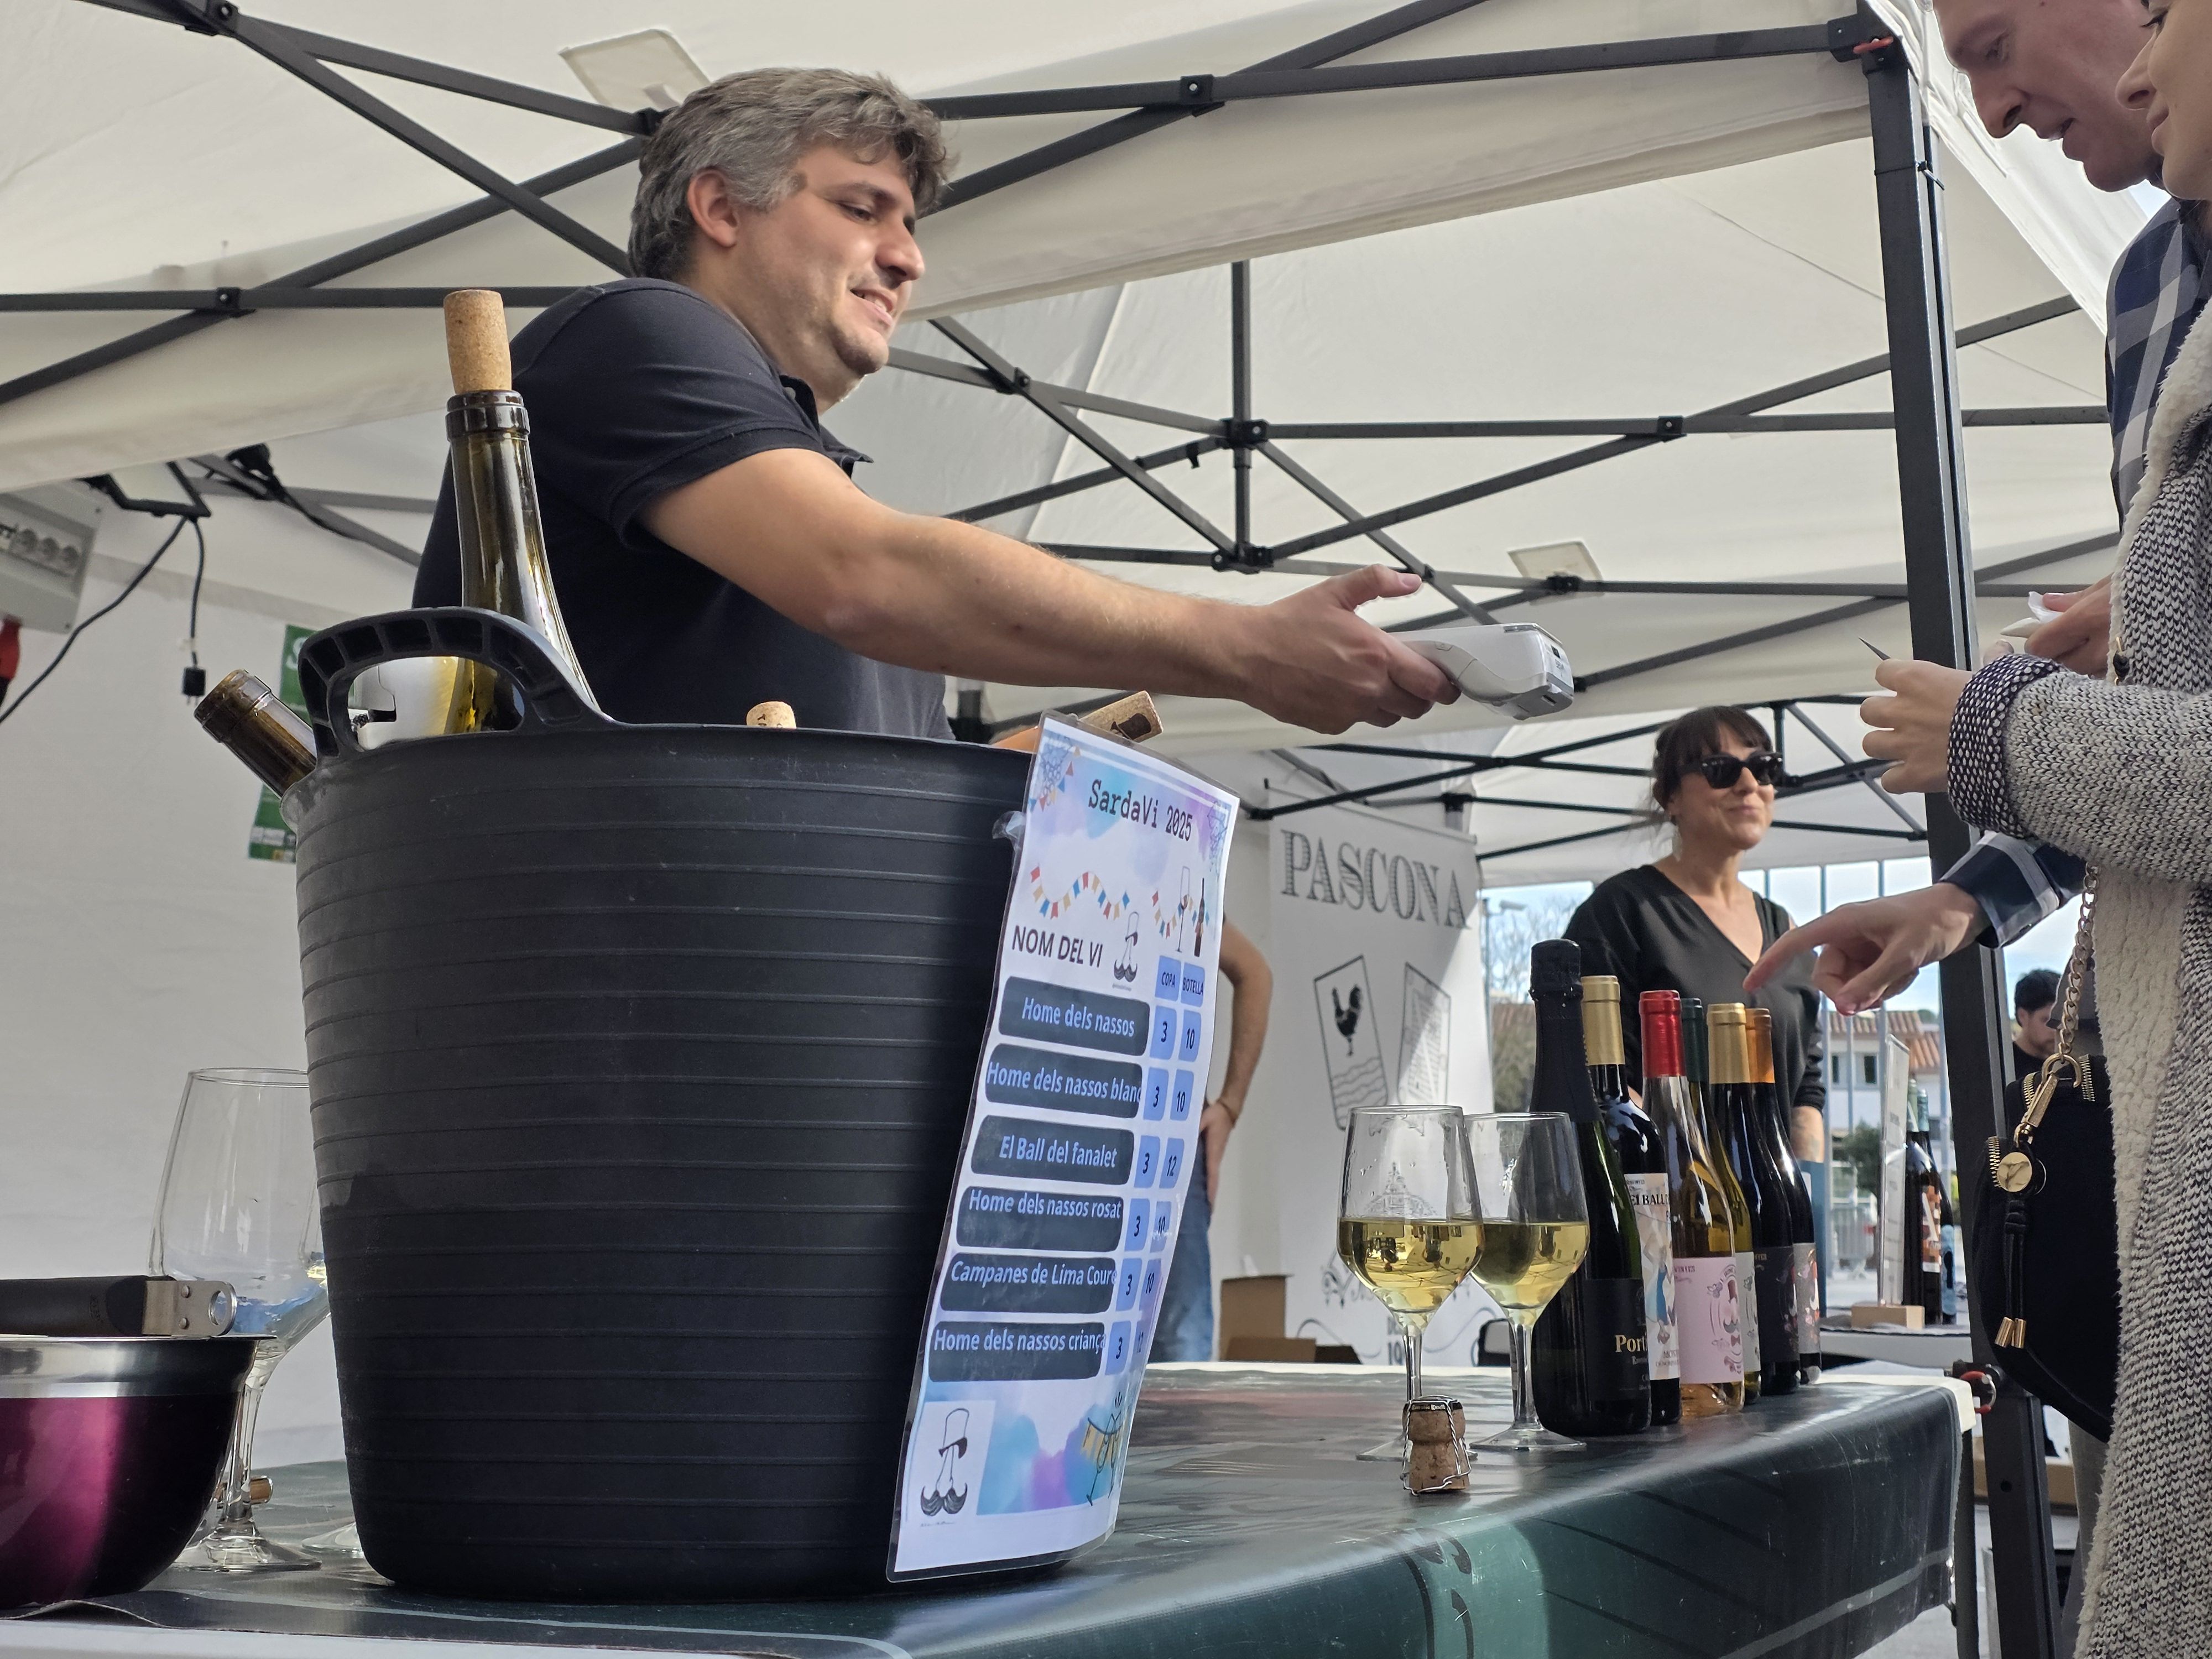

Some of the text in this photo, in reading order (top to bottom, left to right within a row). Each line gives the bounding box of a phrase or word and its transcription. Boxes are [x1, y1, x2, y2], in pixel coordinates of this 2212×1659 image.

[1088, 778, 1193, 842] SardaVi 2025
[1280, 828, 1473, 930] PASCONA
[1011, 925, 1104, 968] NOM DEL VI
[1161, 972, 1176, 988] COPA
[1182, 976, 1204, 995] BOTELLA
[1021, 997, 1135, 1037] Home dels nassos
[1161, 1020, 1168, 1043] 3
[1186, 1027, 1195, 1050] 10
[987, 1061, 1030, 1091] Home
[1034, 1066, 1063, 1093] dels
[1065, 1076, 1108, 1099] nassos
[1152, 1086, 1160, 1108] 3
[1177, 1091, 1186, 1113] 10
[999, 1134, 1118, 1168] El Ball del fanalet
[1142, 1152, 1150, 1175] 3
[1166, 1154, 1177, 1177] 12
[969, 1189, 1122, 1219] Home dels nassos rosat
[1134, 1215, 1141, 1238] 3
[951, 1261, 1117, 1288] Campanes de Lima Coure
[1125, 1273, 1133, 1296] 3
[1145, 1272, 1155, 1295] 10
[933, 1328, 1106, 1353] Home dels nassos criança
[1115, 1336, 1123, 1360] 3
